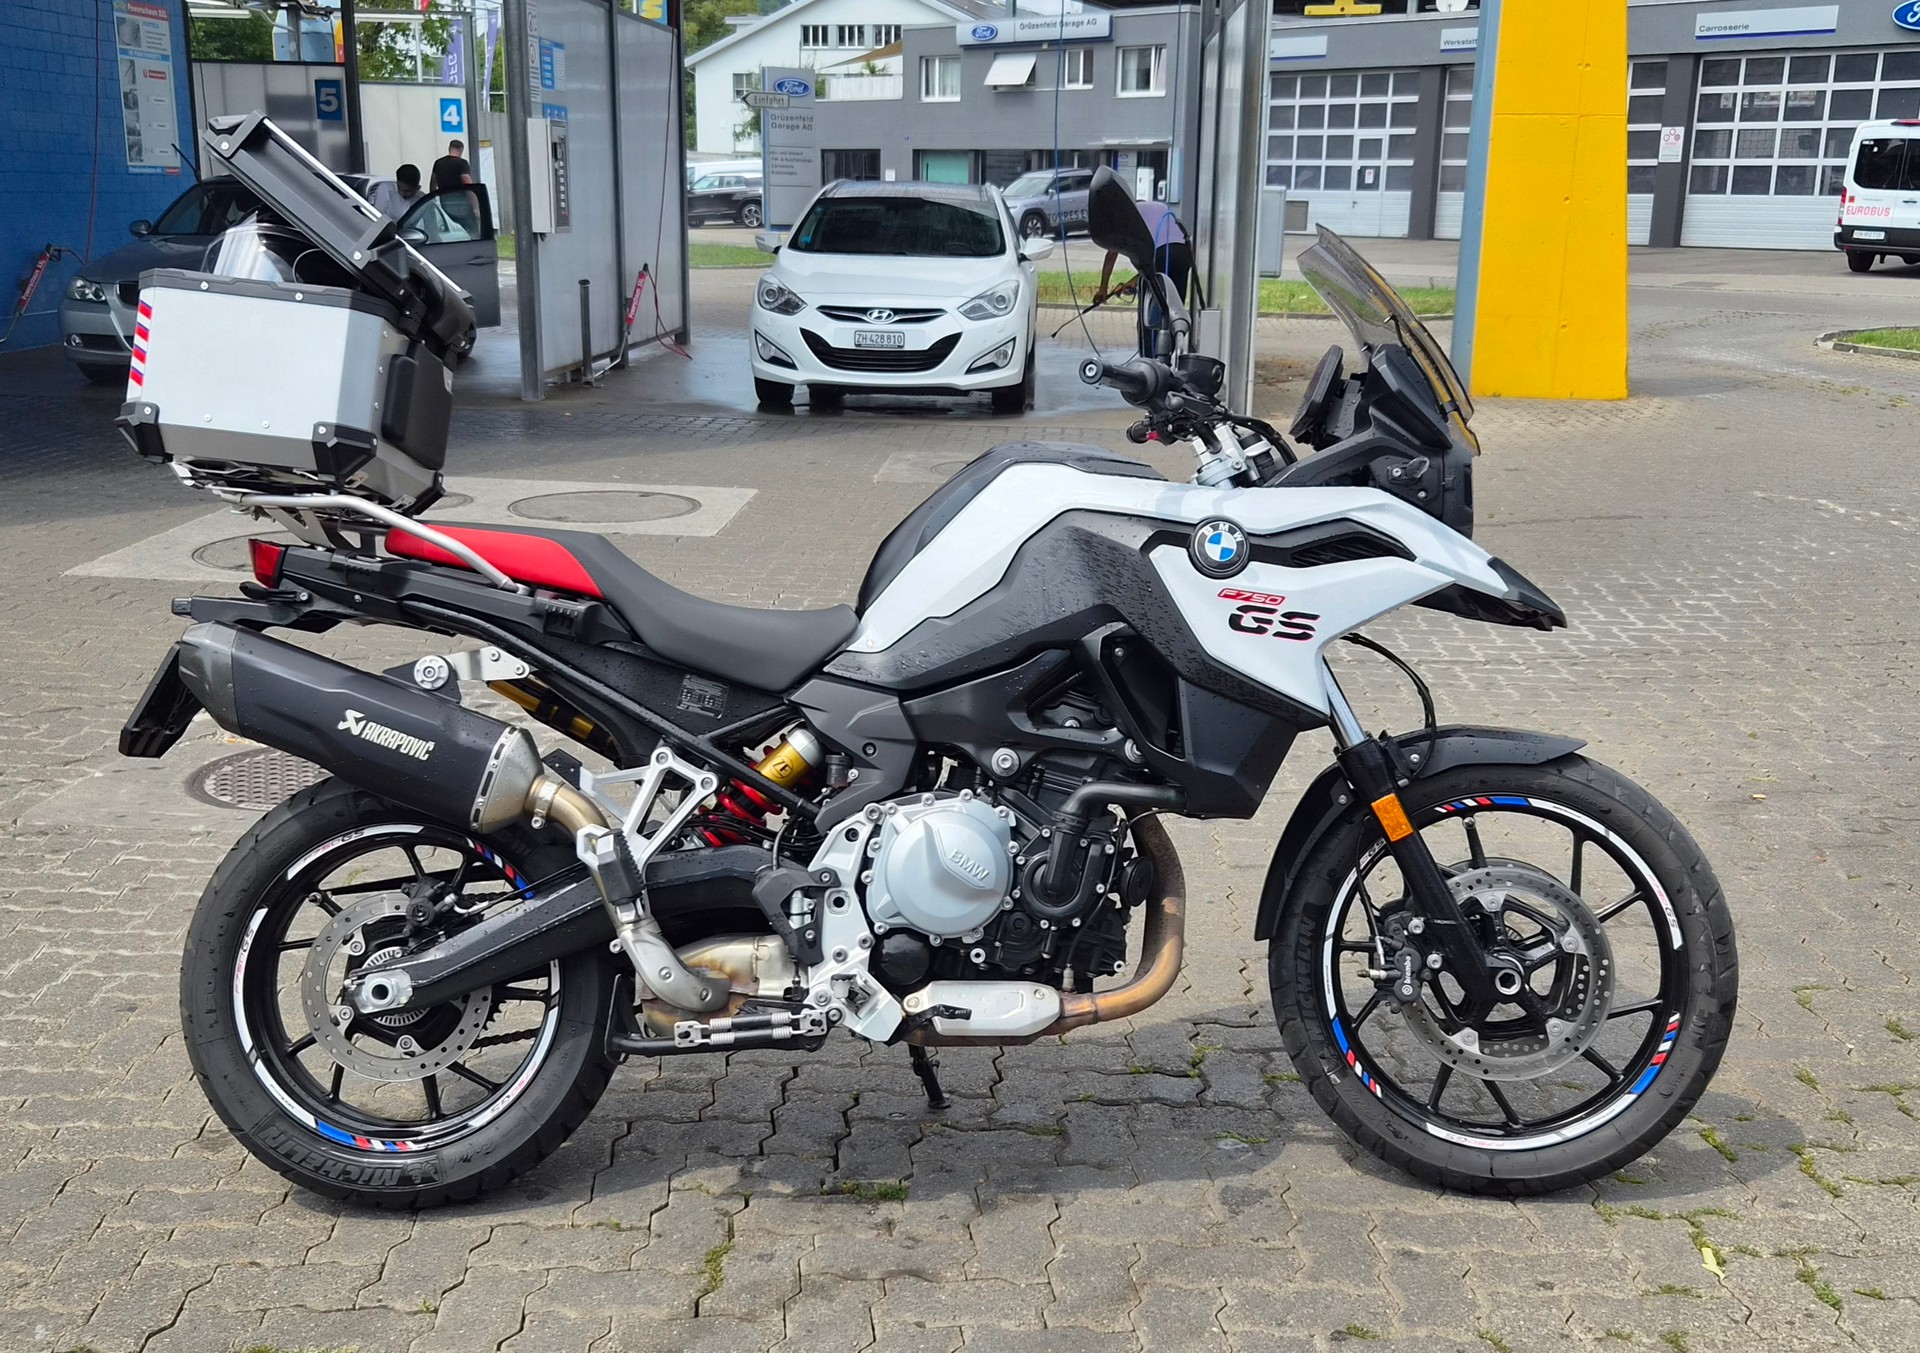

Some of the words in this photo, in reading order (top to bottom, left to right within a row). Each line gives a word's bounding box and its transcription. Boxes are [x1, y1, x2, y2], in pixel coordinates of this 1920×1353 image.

[1019, 19, 1057, 30] Grüzenfeld
[1059, 18, 1085, 29] Garage
[1086, 18, 1097, 26] AG
[1698, 23, 1750, 33] Carrosserie
[781, 80, 805, 93] Ford
[319, 87, 339, 113] 5
[753, 95, 785, 106] Einfahrt
[443, 104, 461, 126] 4
[770, 113, 814, 123] Grüzenfeld
[770, 122, 800, 131] Garage
[1048, 210, 1079, 223] TORRES
[1081, 209, 1088, 219] E
[1846, 205, 1891, 217] EUROBUS
[1202, 522, 1243, 543] BMW
[1219, 589, 1283, 605] F750
[1228, 604, 1320, 641] GS
[948, 847, 990, 882] BMW
[1403, 955, 1412, 984] brembo
[258, 1125, 402, 1187] MICHELIN
